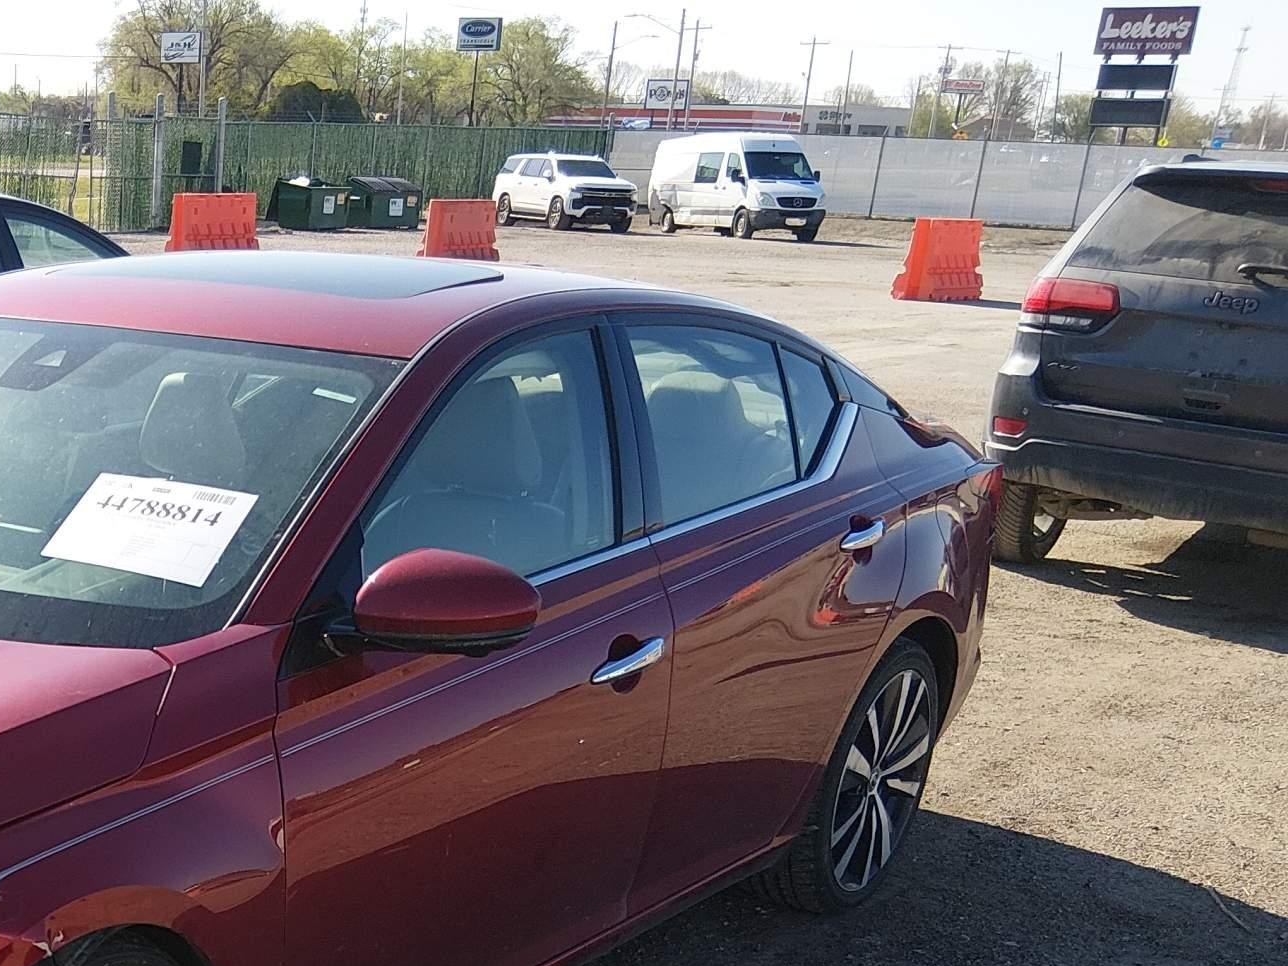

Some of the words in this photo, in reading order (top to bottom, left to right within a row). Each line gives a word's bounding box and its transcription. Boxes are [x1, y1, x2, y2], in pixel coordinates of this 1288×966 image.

[465, 24, 492, 33] Carrier
[1100, 13, 1192, 39] Leeker's
[1102, 42, 1144, 50] FAMILY
[1144, 42, 1183, 50] FOODS
[1204, 291, 1260, 314] Jeep
[96, 494, 223, 526] 44788814
